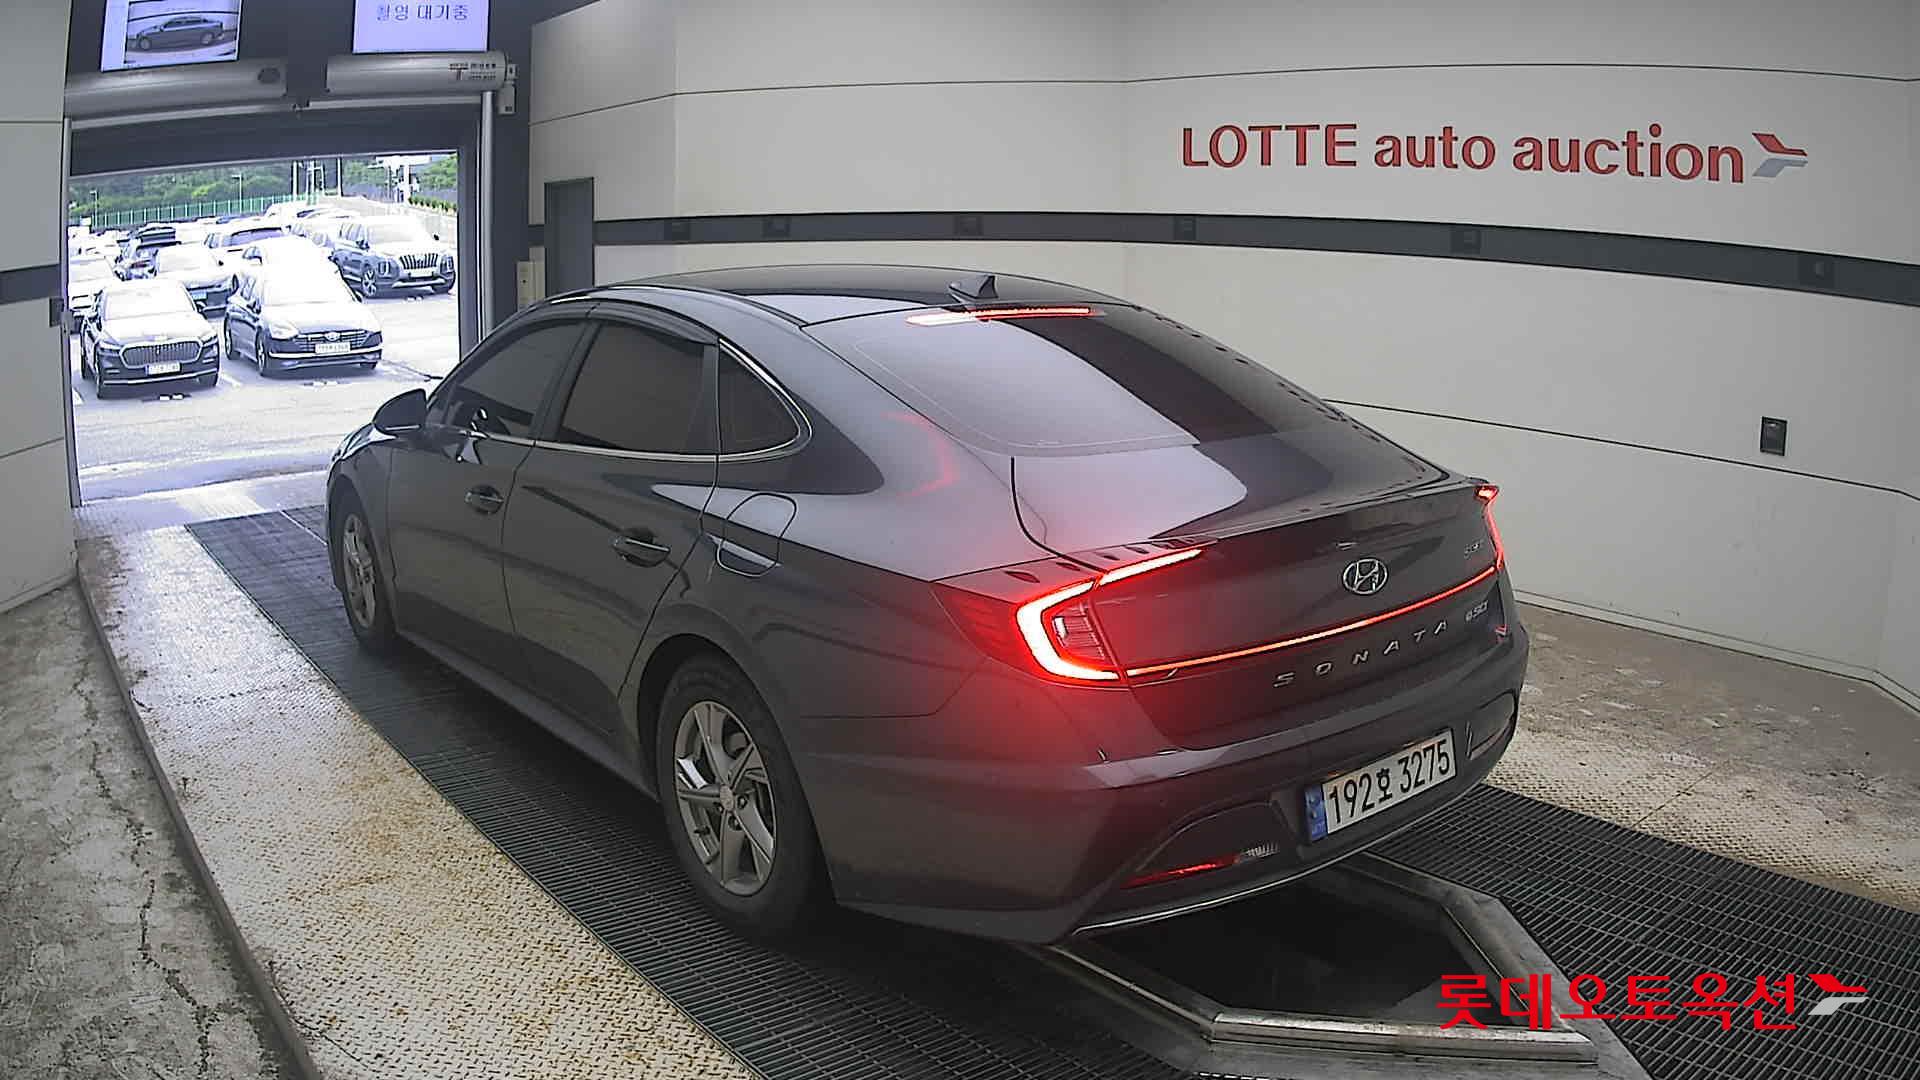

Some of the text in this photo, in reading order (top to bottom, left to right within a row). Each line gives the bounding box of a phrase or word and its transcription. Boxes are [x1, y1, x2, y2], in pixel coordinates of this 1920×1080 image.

[1182, 123, 1744, 184] LOTTE auto auction
[1273, 619, 1448, 688] SONATA
[1398, 739, 1451, 793] 3275
